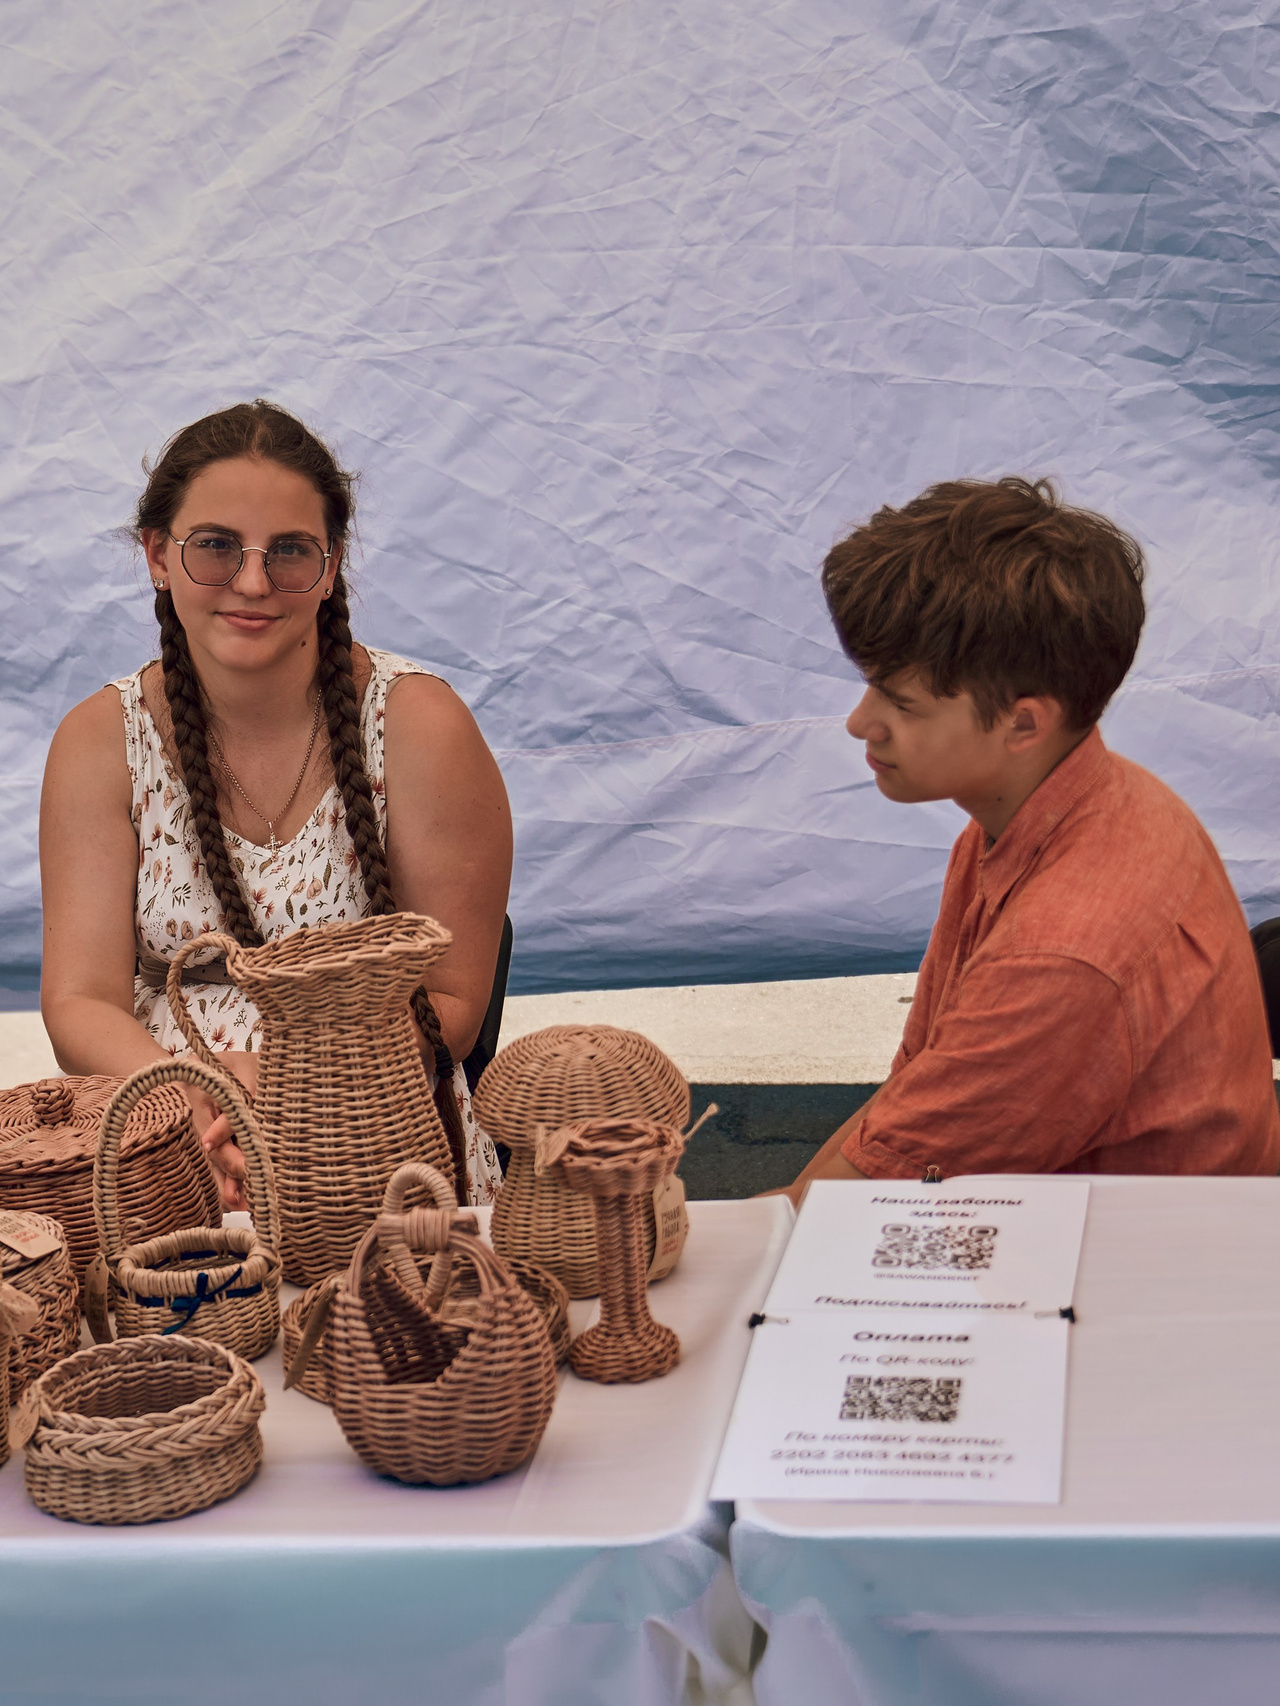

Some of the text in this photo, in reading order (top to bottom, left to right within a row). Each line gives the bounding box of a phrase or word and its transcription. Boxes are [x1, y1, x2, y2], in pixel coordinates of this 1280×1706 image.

[871, 1196, 1023, 1206] Наши работы
[813, 1295, 1028, 1310] Подписывайтесь!
[853, 1331, 970, 1343] Оплата
[839, 1354, 870, 1364] По
[784, 1432, 816, 1442] По
[822, 1433, 911, 1444] номеру
[770, 1450, 826, 1460] 2202
